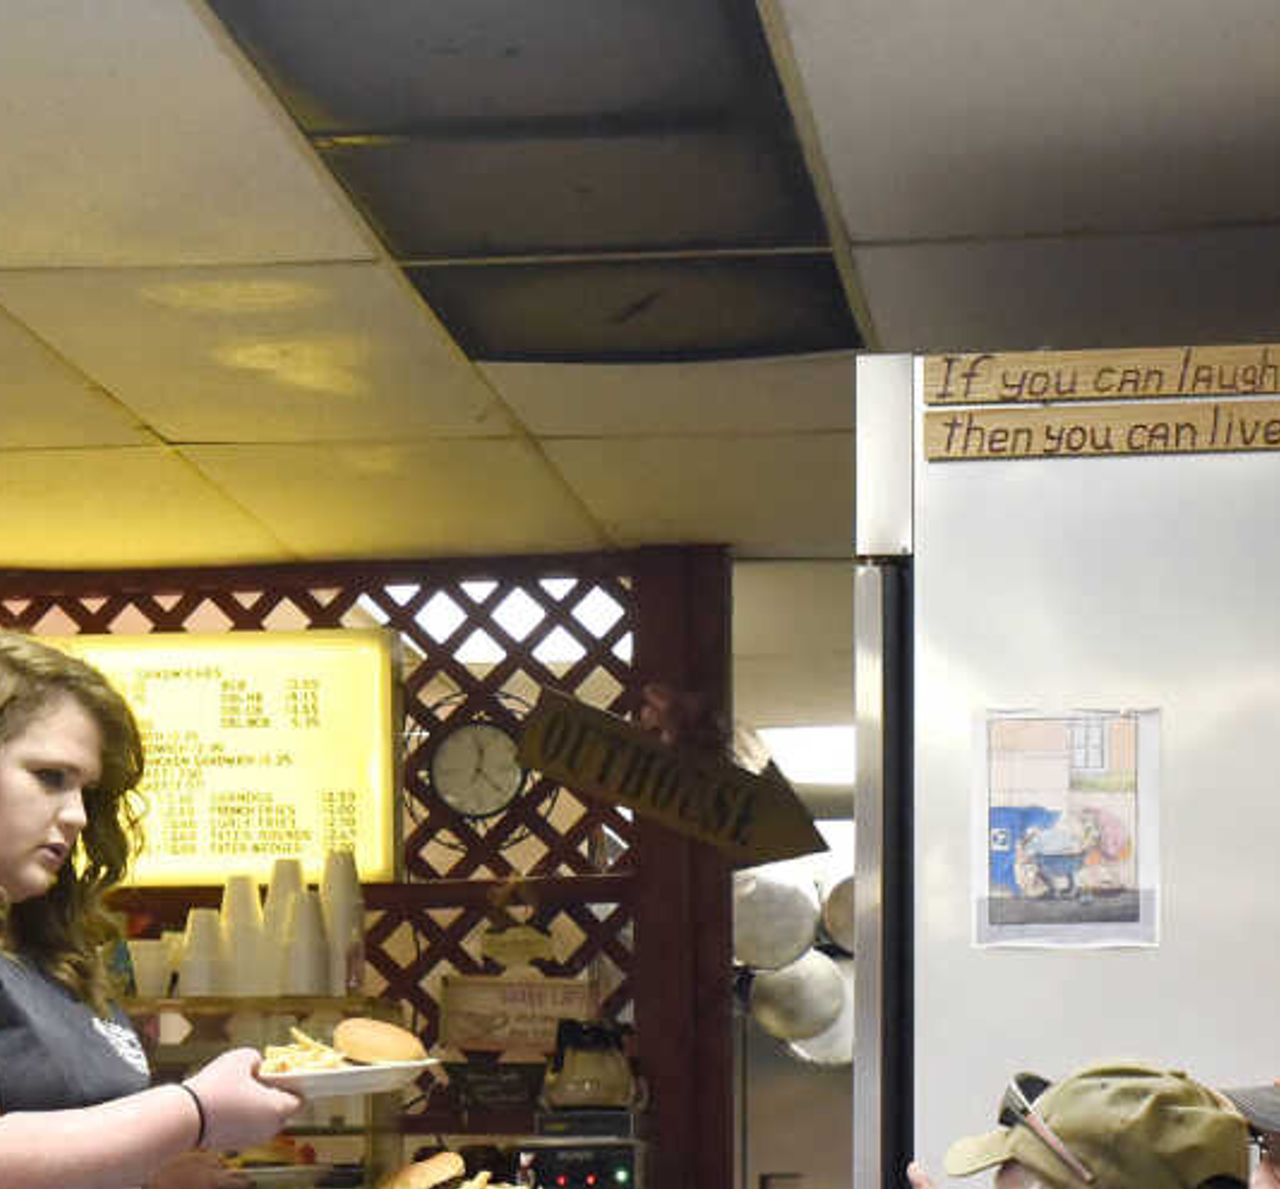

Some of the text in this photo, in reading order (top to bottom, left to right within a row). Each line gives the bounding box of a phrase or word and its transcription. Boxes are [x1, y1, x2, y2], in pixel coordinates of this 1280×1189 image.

[936, 354, 996, 400] If
[999, 365, 1077, 400] you
[942, 412, 1033, 454] then
[1042, 418, 1113, 454] you
[542, 705, 756, 847] OUTHOUSE
